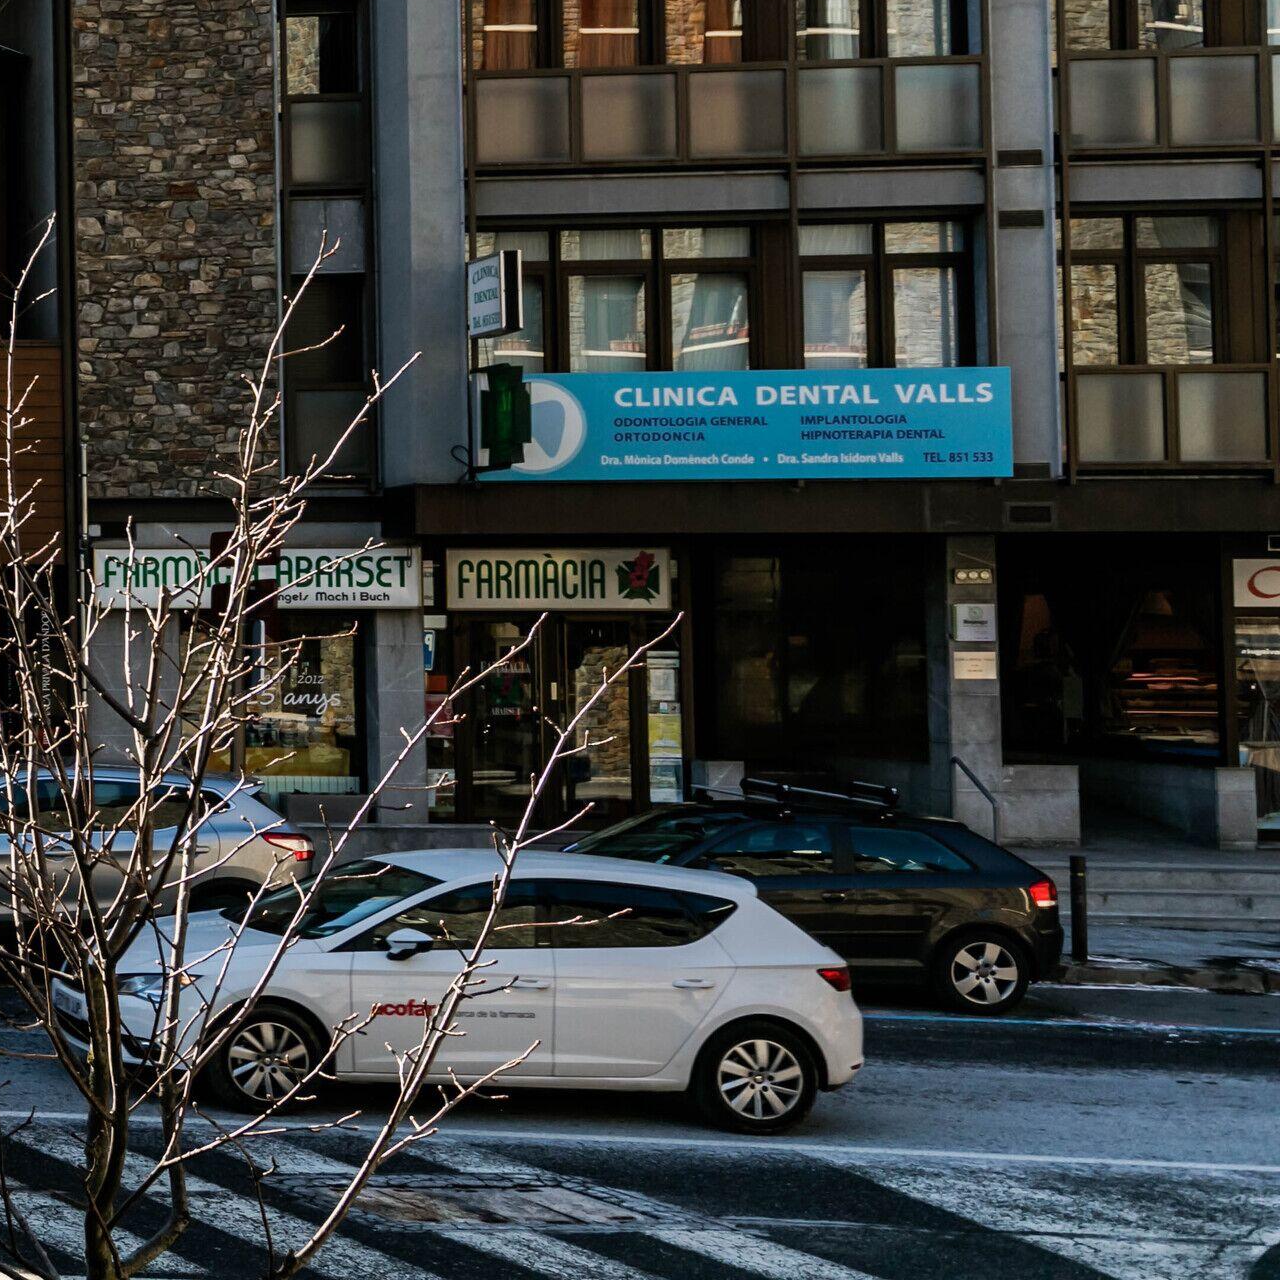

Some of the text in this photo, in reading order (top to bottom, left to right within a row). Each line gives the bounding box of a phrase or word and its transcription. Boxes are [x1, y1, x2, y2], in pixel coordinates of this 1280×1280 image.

[613, 382, 994, 408] CLINICA DENTAL VALLS
[613, 415, 768, 428] ODONTOLOGIA GENERAL
[800, 414, 908, 426] IMPLANTOLOGIA
[613, 431, 705, 443] ORTODONCIA
[800, 428, 946, 441] HIPNOTERAPIA DENTAL
[600, 454, 622, 465] Dra.
[721, 453, 755, 465] Conde
[777, 452, 904, 464] Dra. Sandra Isidore Valls
[923, 451, 994, 463] TEL. 851 533
[275, 554, 412, 588] ABARSET
[458, 553, 606, 600] FARMÀCIA
[315, 591, 349, 602] Mach
[359, 591, 390, 602] Buch
[297, 674, 326, 685] 2012
[283, 692, 342, 715] anys
